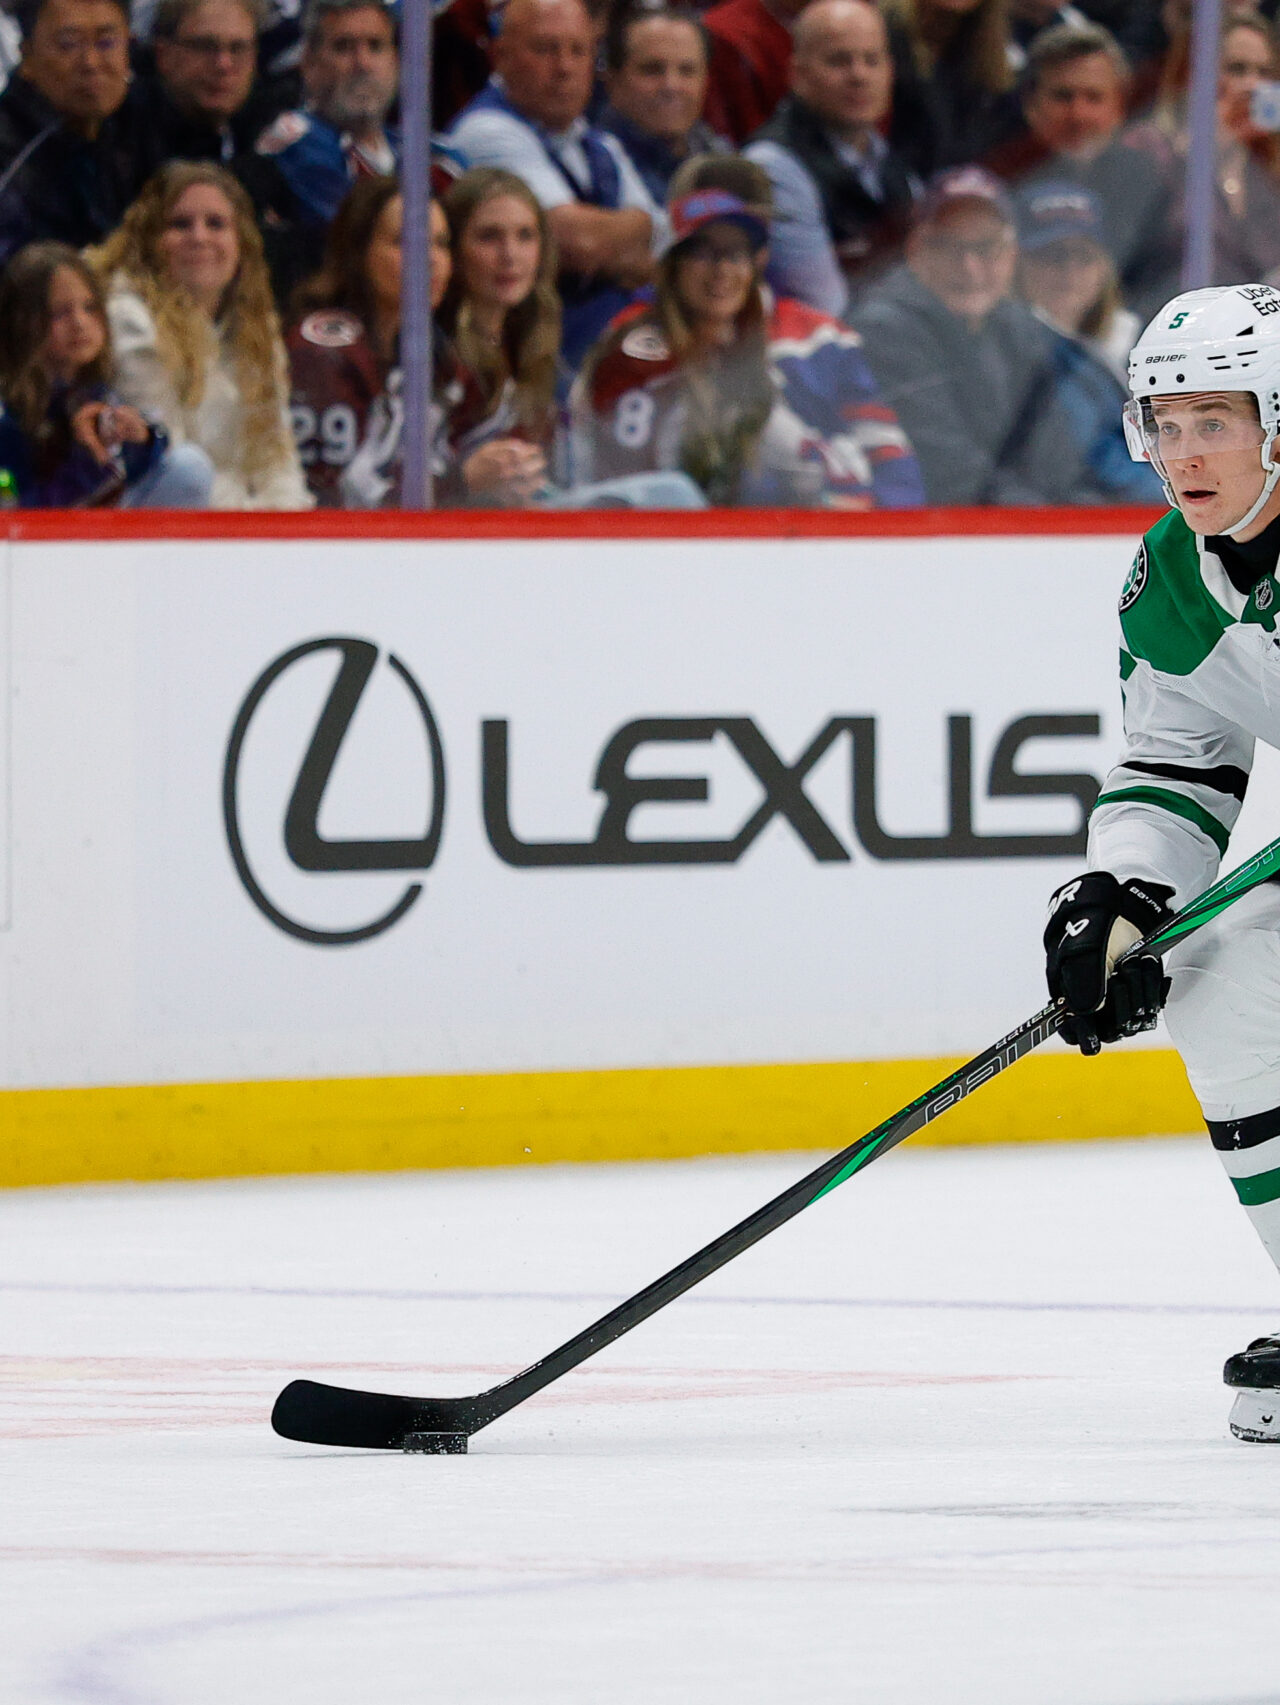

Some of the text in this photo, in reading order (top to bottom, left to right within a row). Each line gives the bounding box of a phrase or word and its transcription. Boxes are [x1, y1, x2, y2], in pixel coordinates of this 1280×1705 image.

[1237, 285, 1276, 301] Uber
[1168, 312, 1189, 329] 5
[616, 389, 655, 448] 8
[481, 713, 1101, 867] LEXUS
